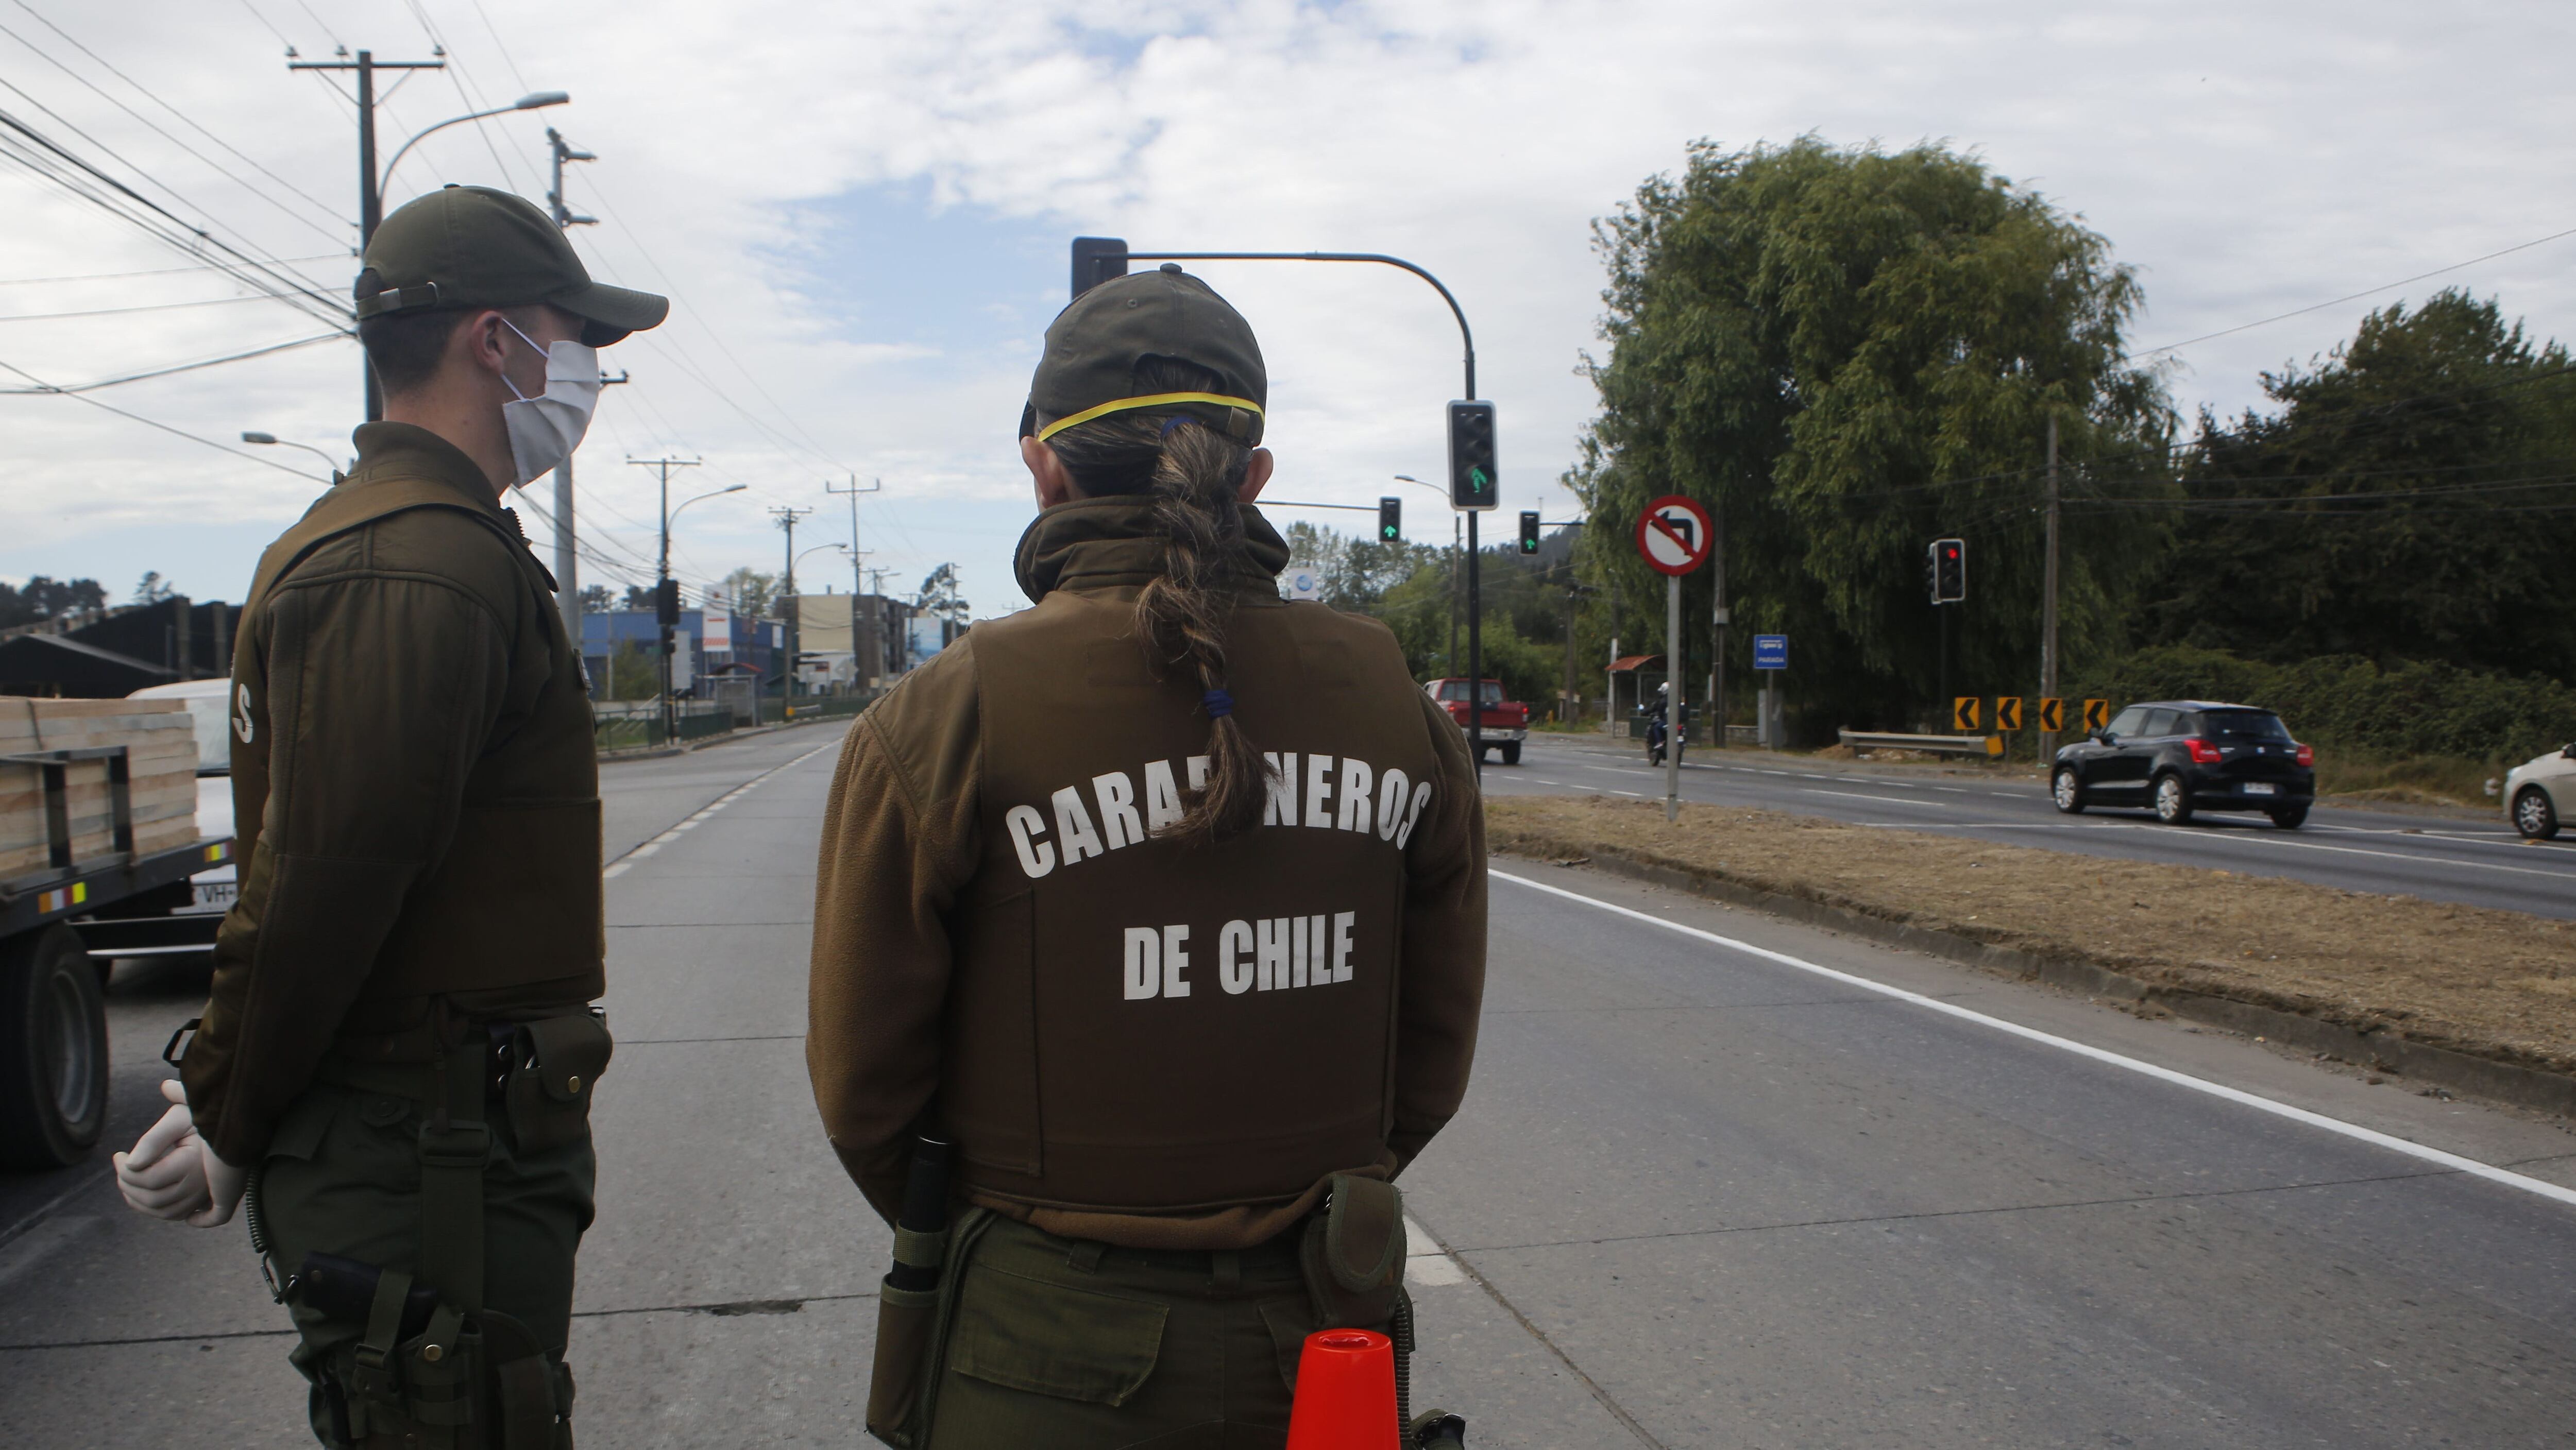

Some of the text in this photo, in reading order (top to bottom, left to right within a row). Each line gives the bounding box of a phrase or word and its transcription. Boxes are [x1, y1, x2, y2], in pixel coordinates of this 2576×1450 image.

[1006, 752, 1432, 878] CARANEROS
[1124, 911, 1355, 1000] DE CHILE
